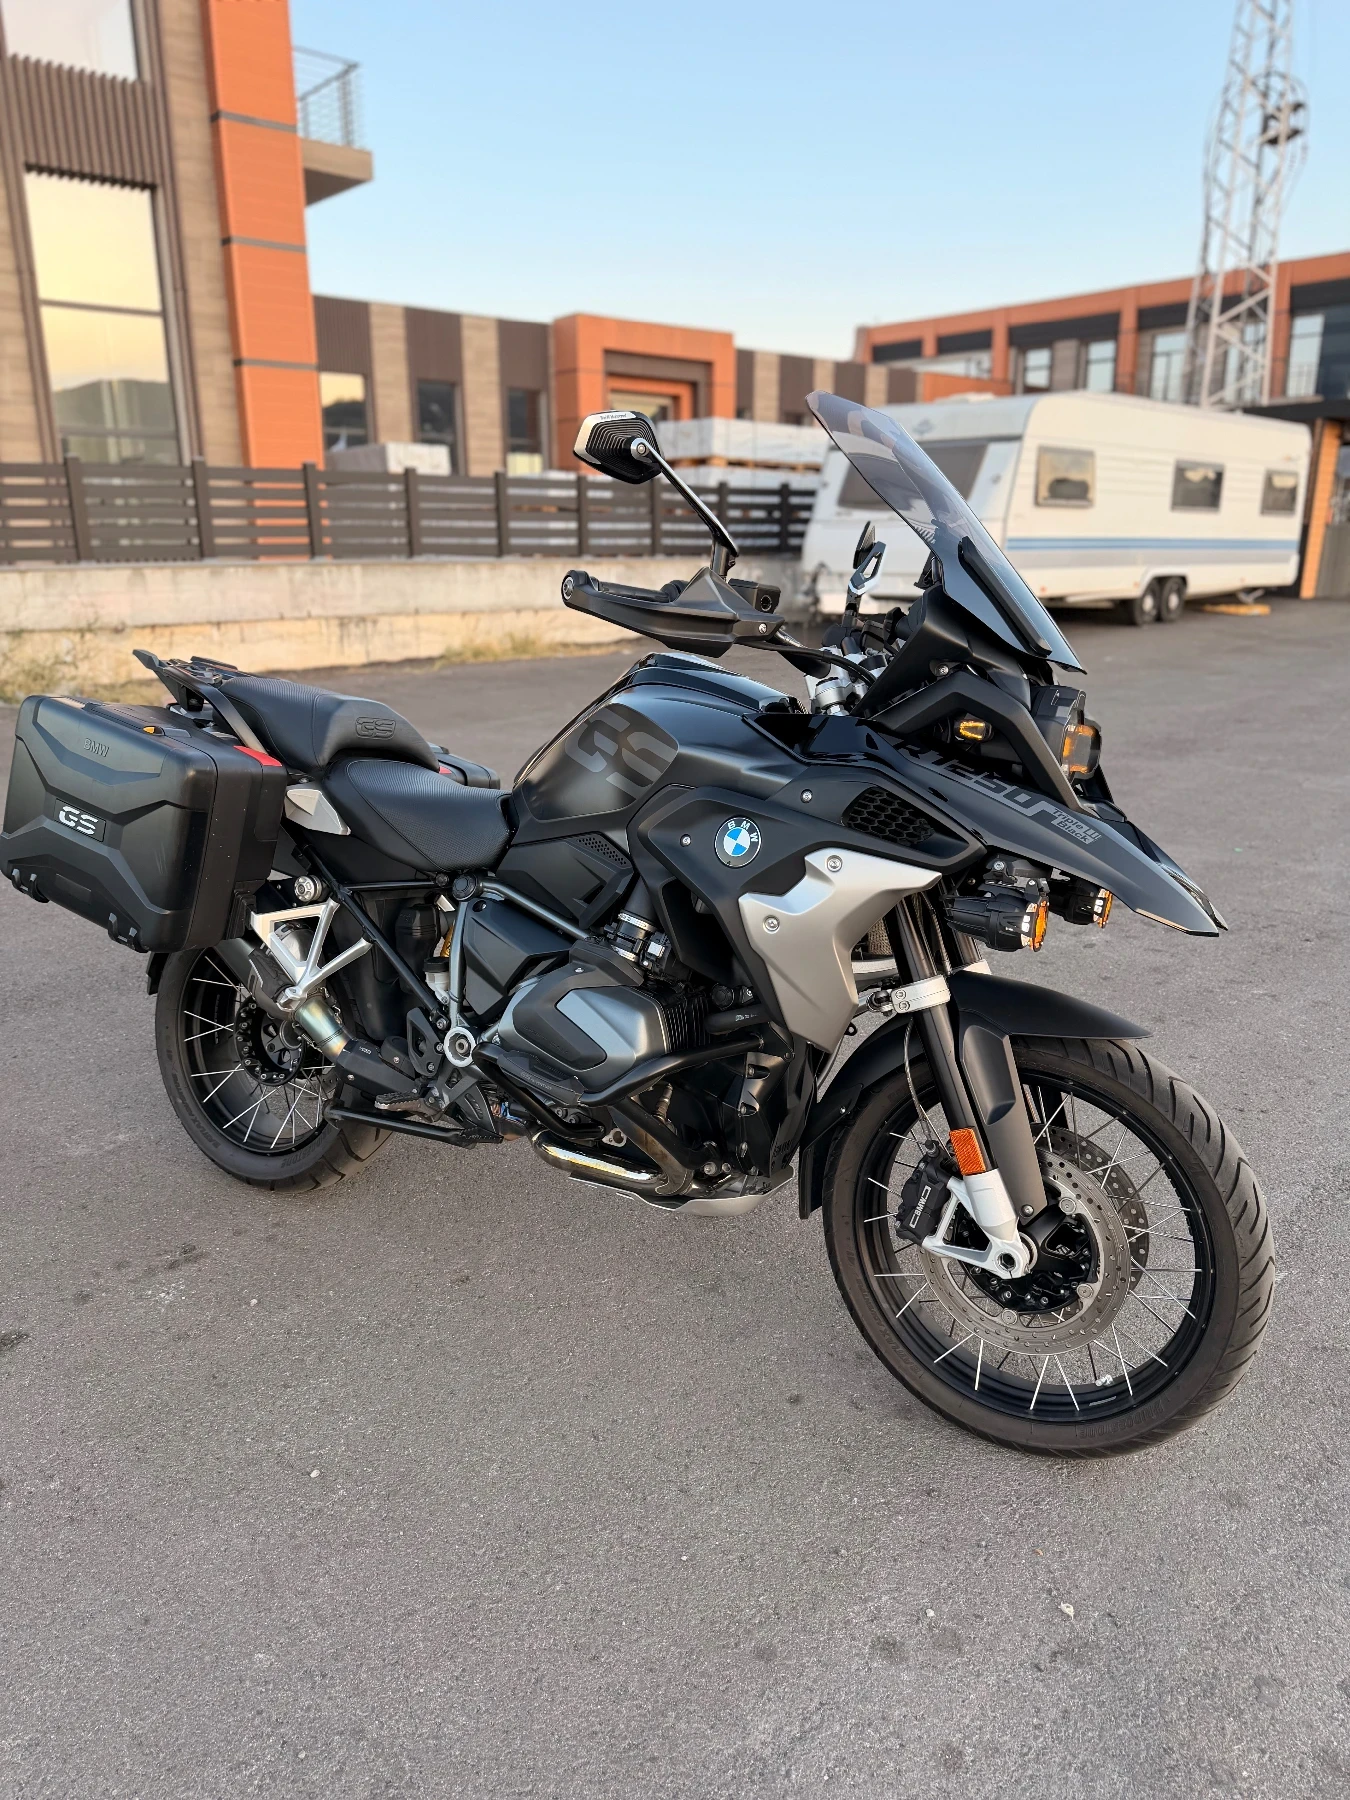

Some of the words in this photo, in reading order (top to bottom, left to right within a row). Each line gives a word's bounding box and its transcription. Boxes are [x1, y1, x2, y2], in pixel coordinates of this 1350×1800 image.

[356, 717, 395, 739] GS
[83, 738, 110, 757] BMW
[58, 805, 98, 835] GS
[1052, 808, 1084, 831] Triple
[727, 820, 759, 842] BMW
[1057, 820, 1090, 844] Black
[914, 1196, 928, 1216] BMW
